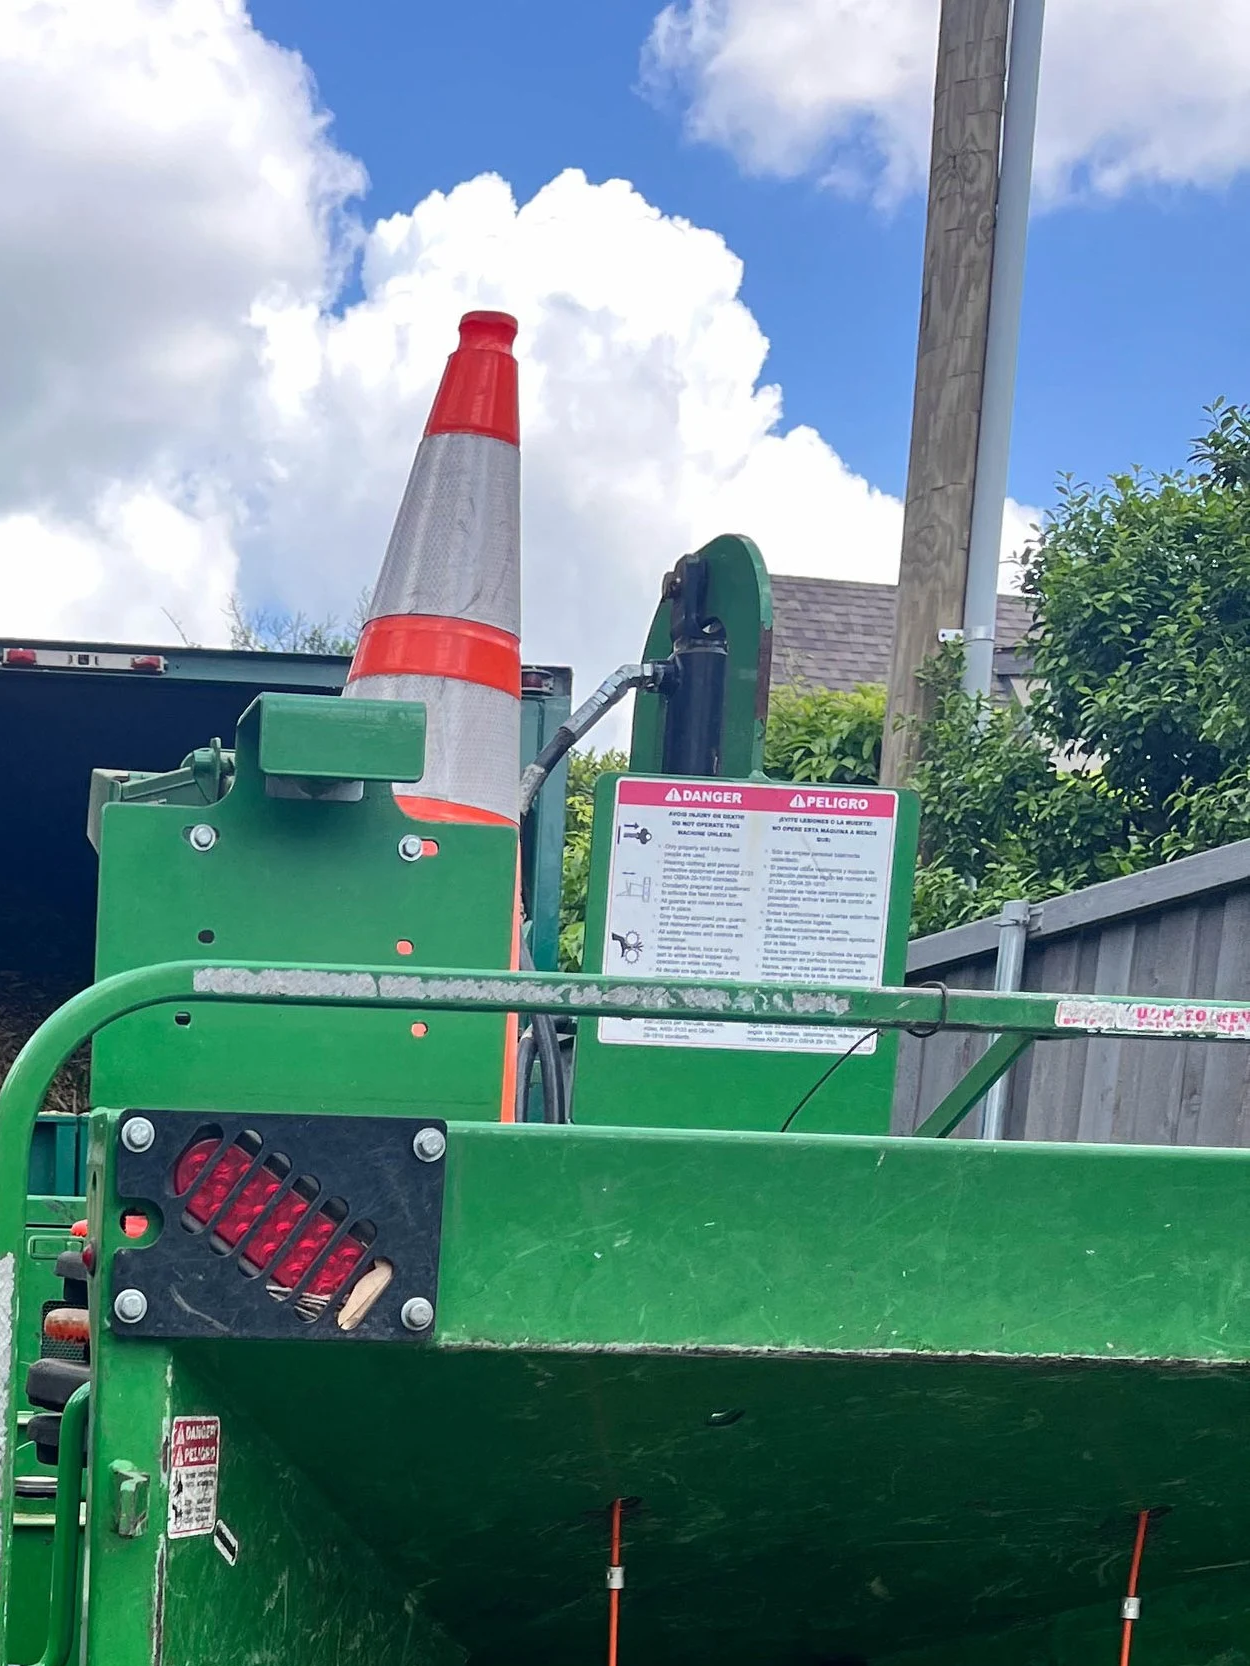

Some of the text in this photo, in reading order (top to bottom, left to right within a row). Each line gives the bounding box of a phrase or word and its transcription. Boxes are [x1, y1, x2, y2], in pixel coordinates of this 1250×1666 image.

[682, 789, 743, 805] DANGER
[805, 795, 871, 811] PELIGRO
[185, 1423, 217, 1442] DANGER
[184, 1445, 216, 1464] PELIGRO
